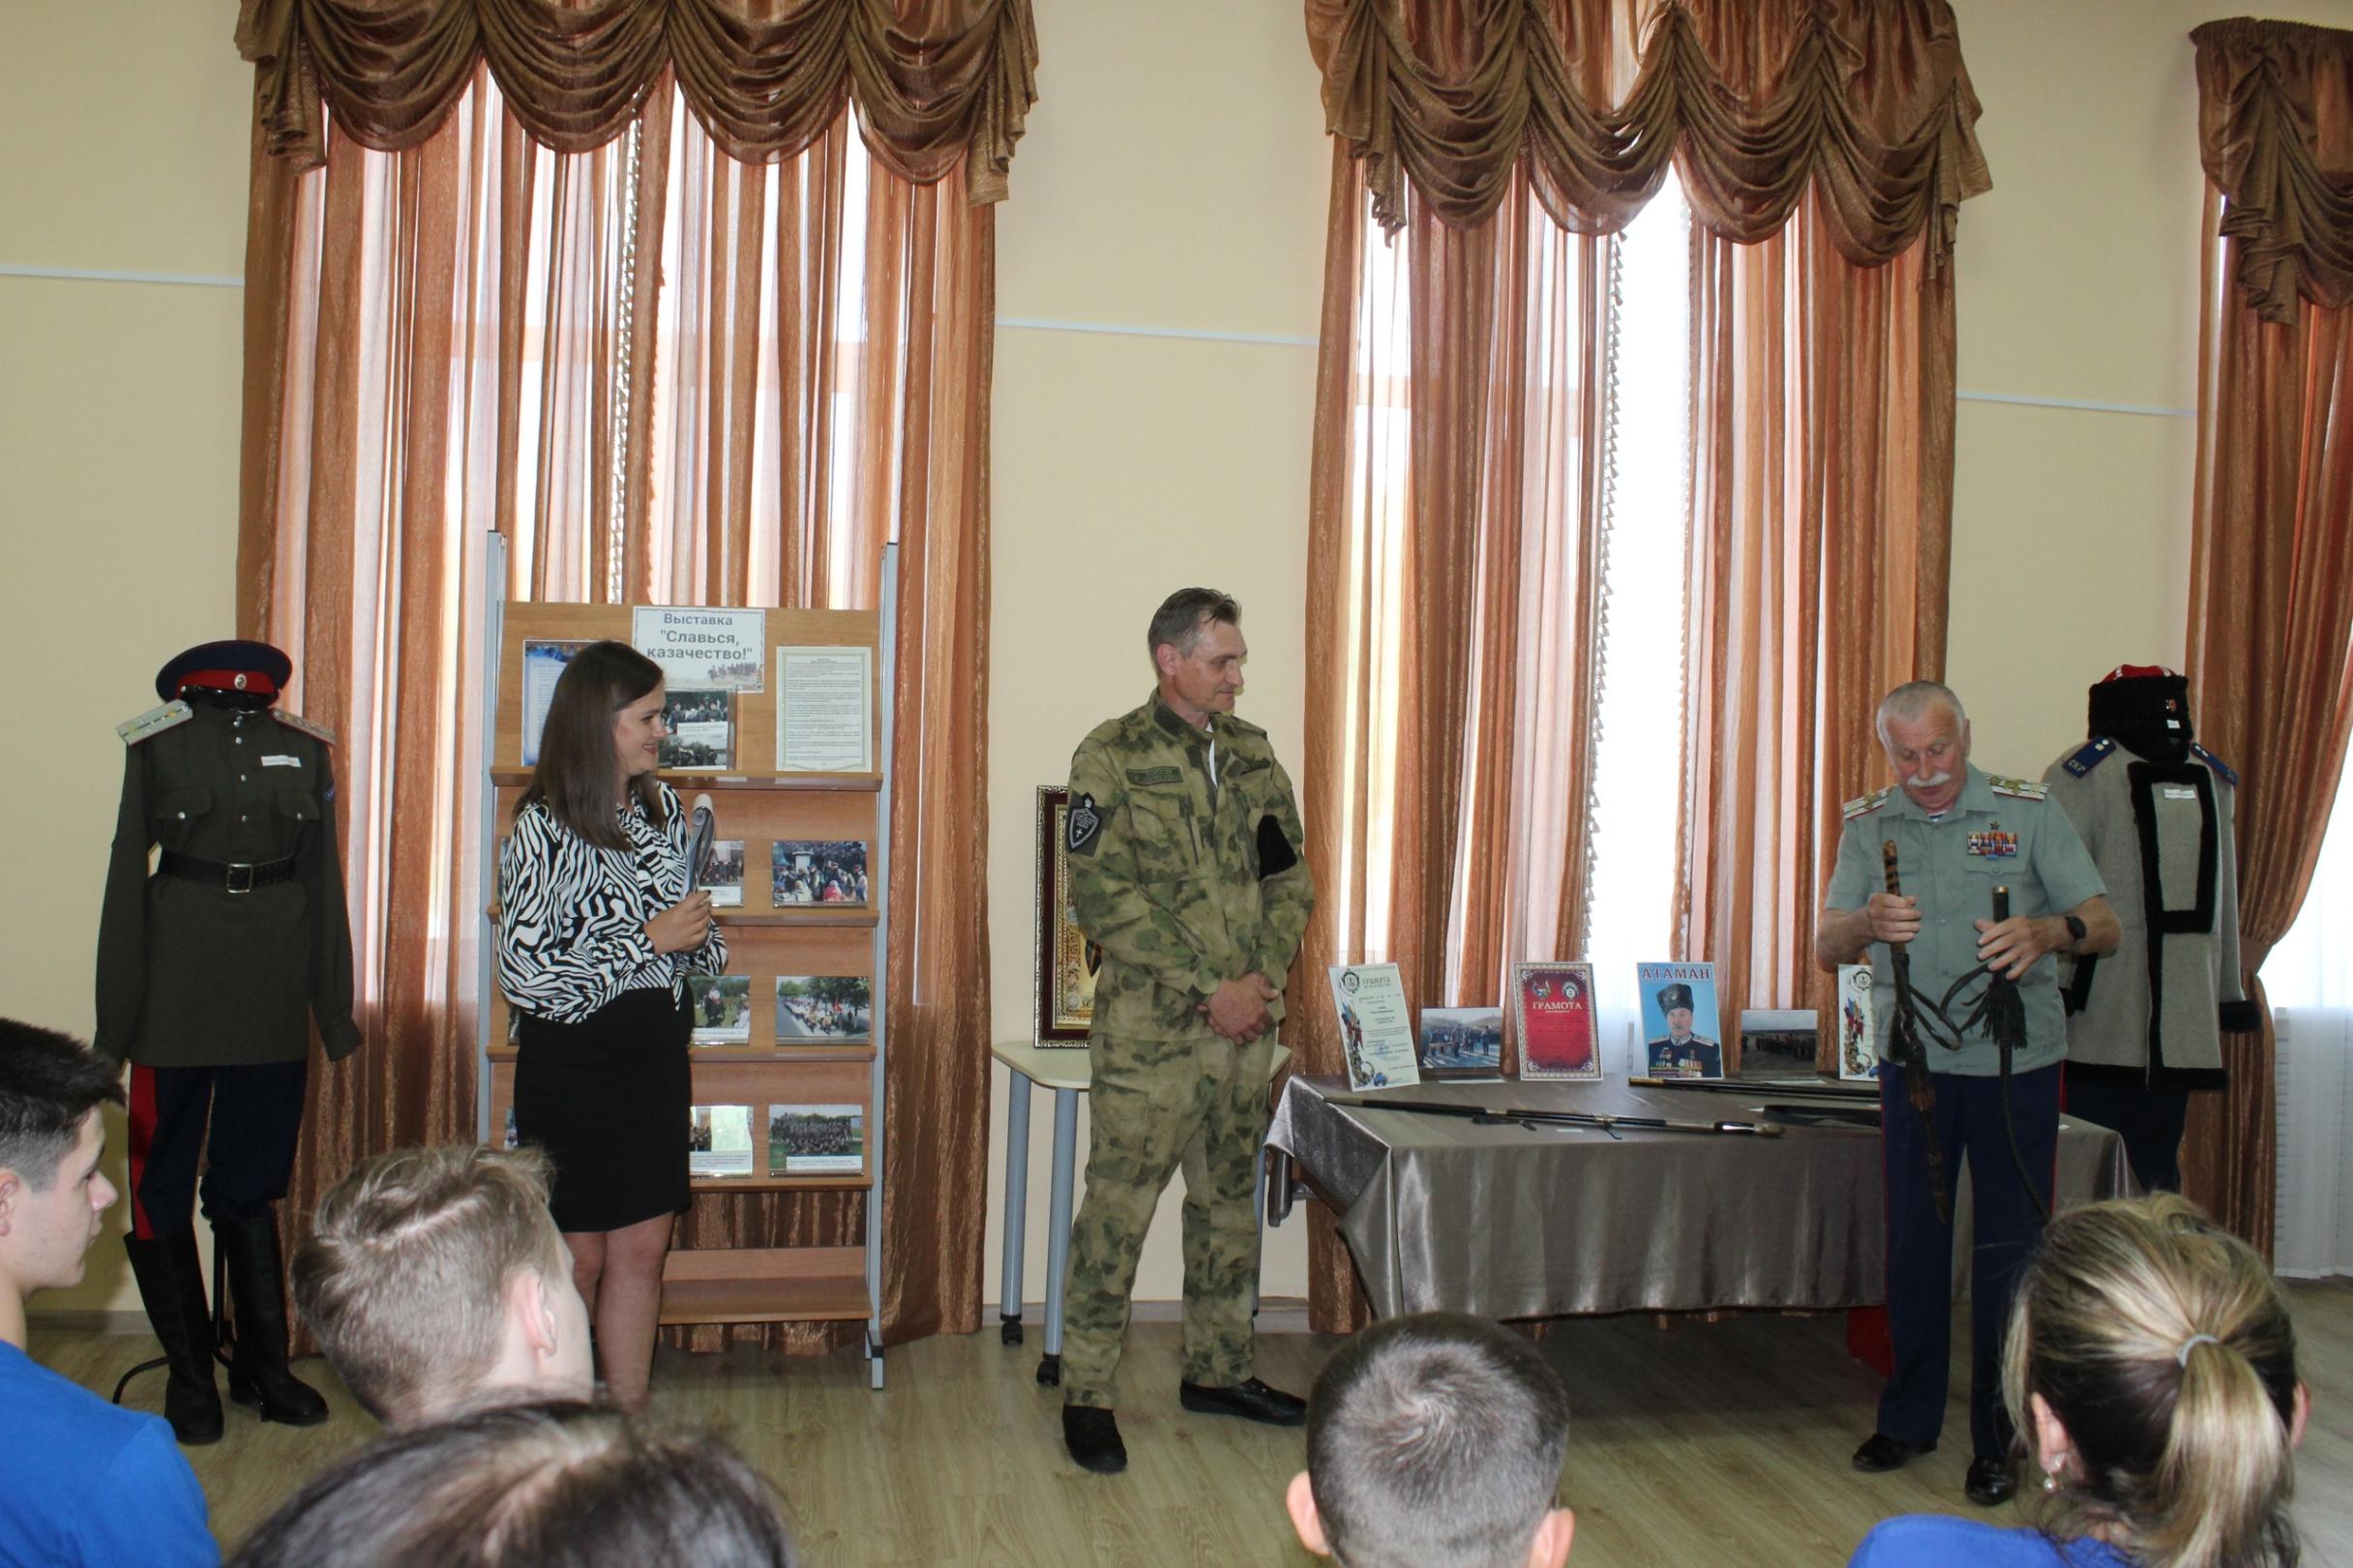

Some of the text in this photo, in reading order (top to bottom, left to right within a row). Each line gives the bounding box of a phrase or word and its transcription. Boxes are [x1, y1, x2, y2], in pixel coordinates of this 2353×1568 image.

[664, 612, 732, 626] Выставка
[660, 629, 739, 646] "Славься,
[647, 647, 753, 660] казачество!"
[1642, 967, 1710, 980] АТАМАН
[1533, 1001, 1583, 1011] ГРАМОТА
